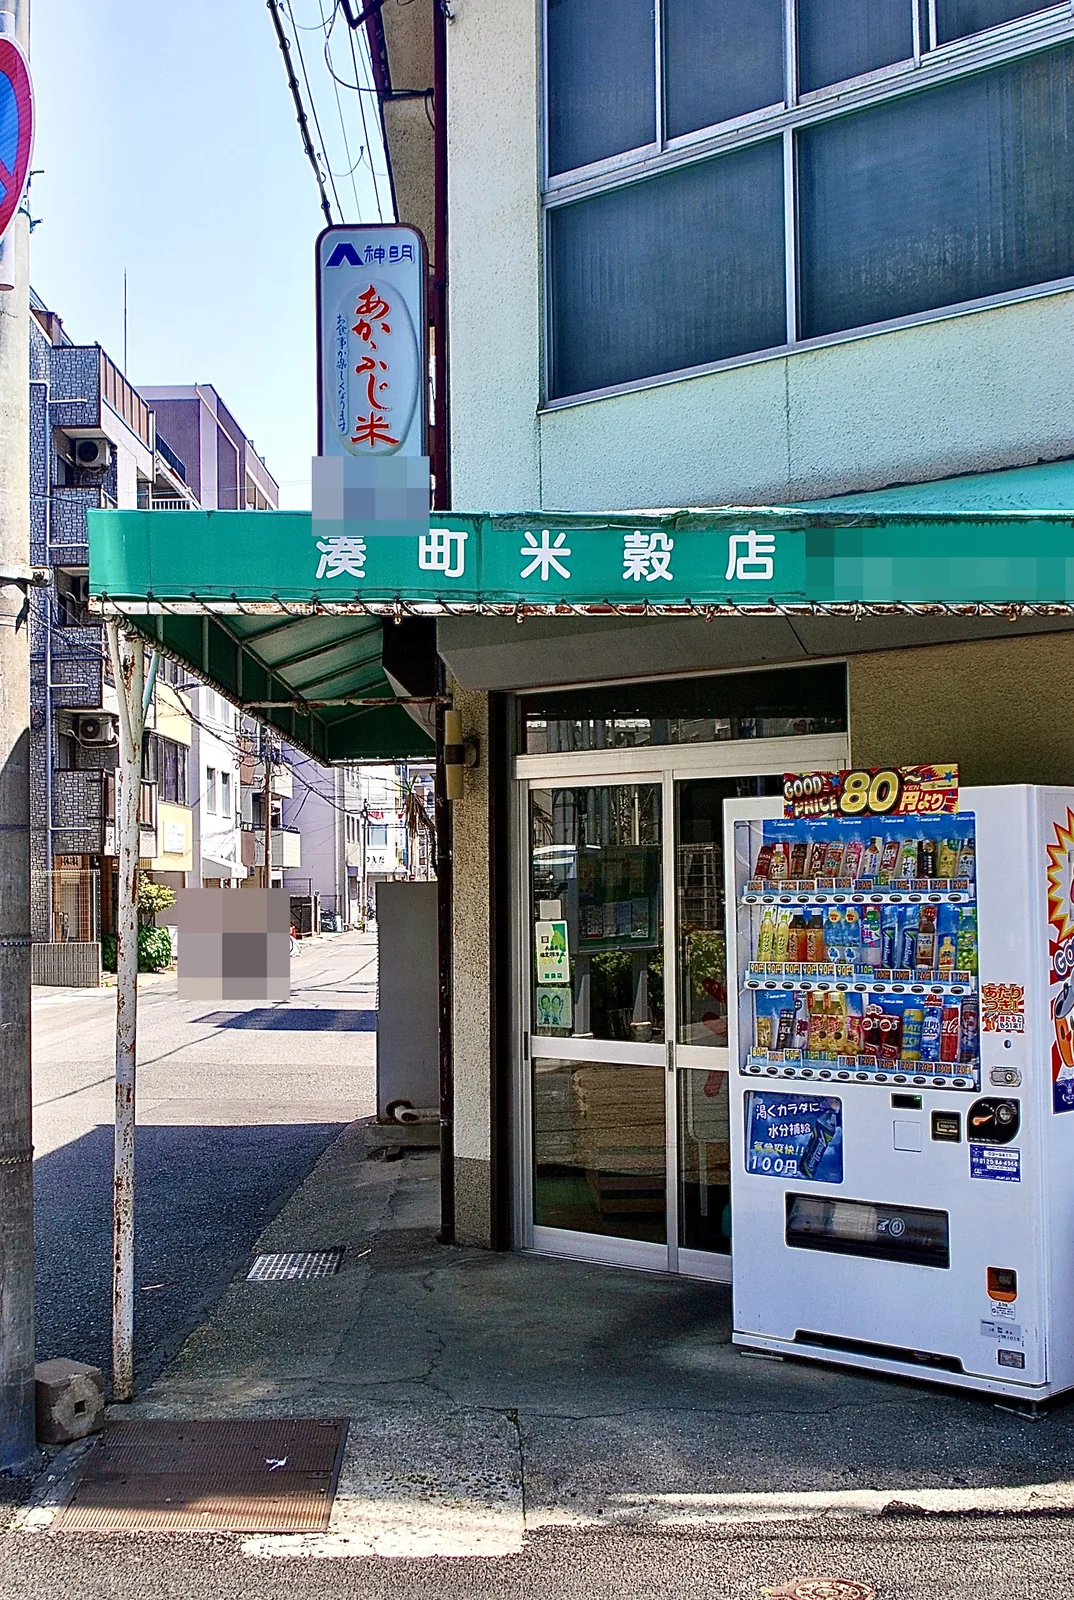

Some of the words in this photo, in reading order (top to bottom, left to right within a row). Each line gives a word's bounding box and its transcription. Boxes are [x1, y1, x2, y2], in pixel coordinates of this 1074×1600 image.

[363, 244, 413, 265] 神明
[351, 284, 400, 447] あかふじ米
[784, 776, 822, 798] GOOD
[840, 771, 900, 814] 80
[794, 797, 838, 817] PRICE
[985, 986, 1022, 999] あたり
[756, 1103, 820, 1120] 渇くカラダに
[768, 1123, 811, 1139] 水分補給
[752, 1155, 798, 1174] 100円
